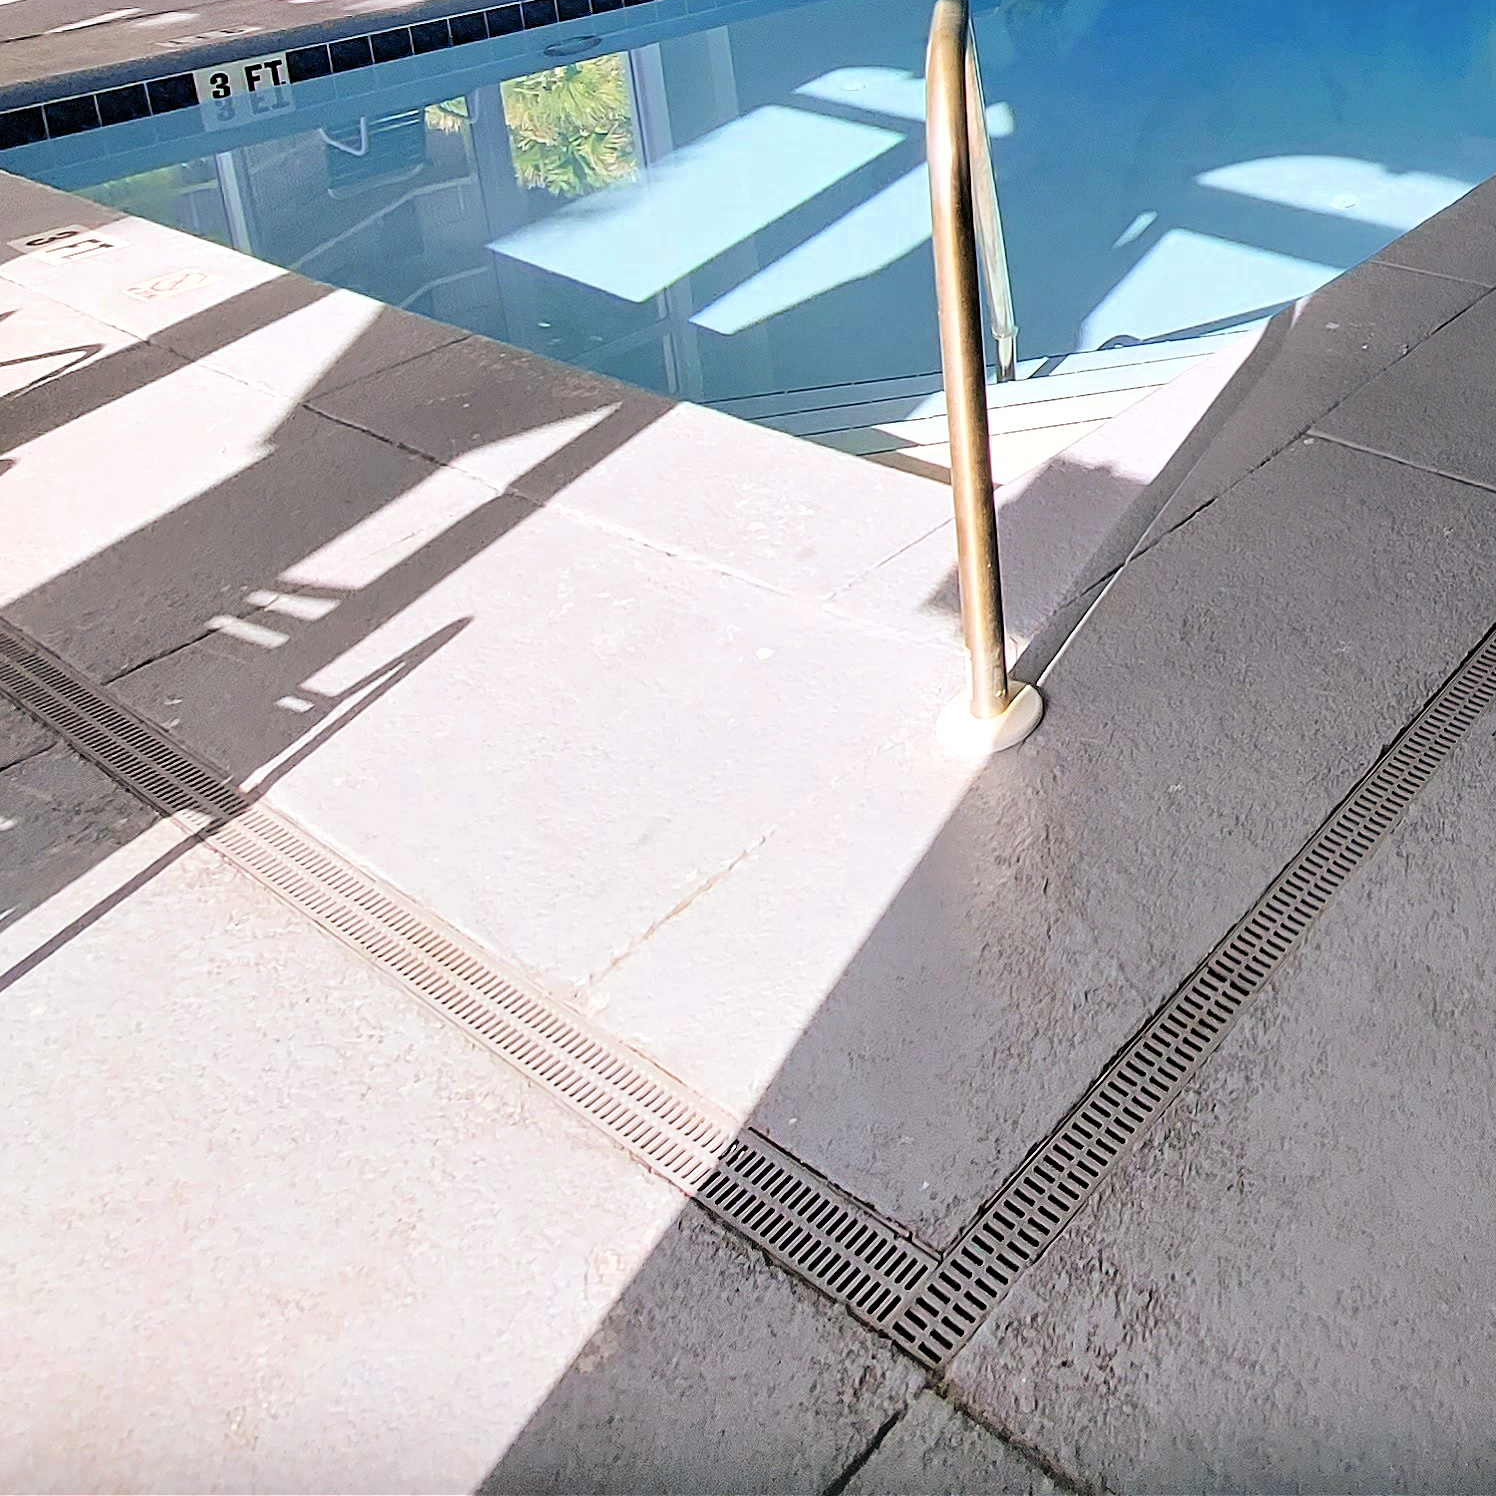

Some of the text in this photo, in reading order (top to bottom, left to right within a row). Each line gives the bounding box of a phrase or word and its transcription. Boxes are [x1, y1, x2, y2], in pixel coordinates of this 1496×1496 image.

[210, 72, 231, 99] 3
[26, 231, 115, 260] 3 FT
